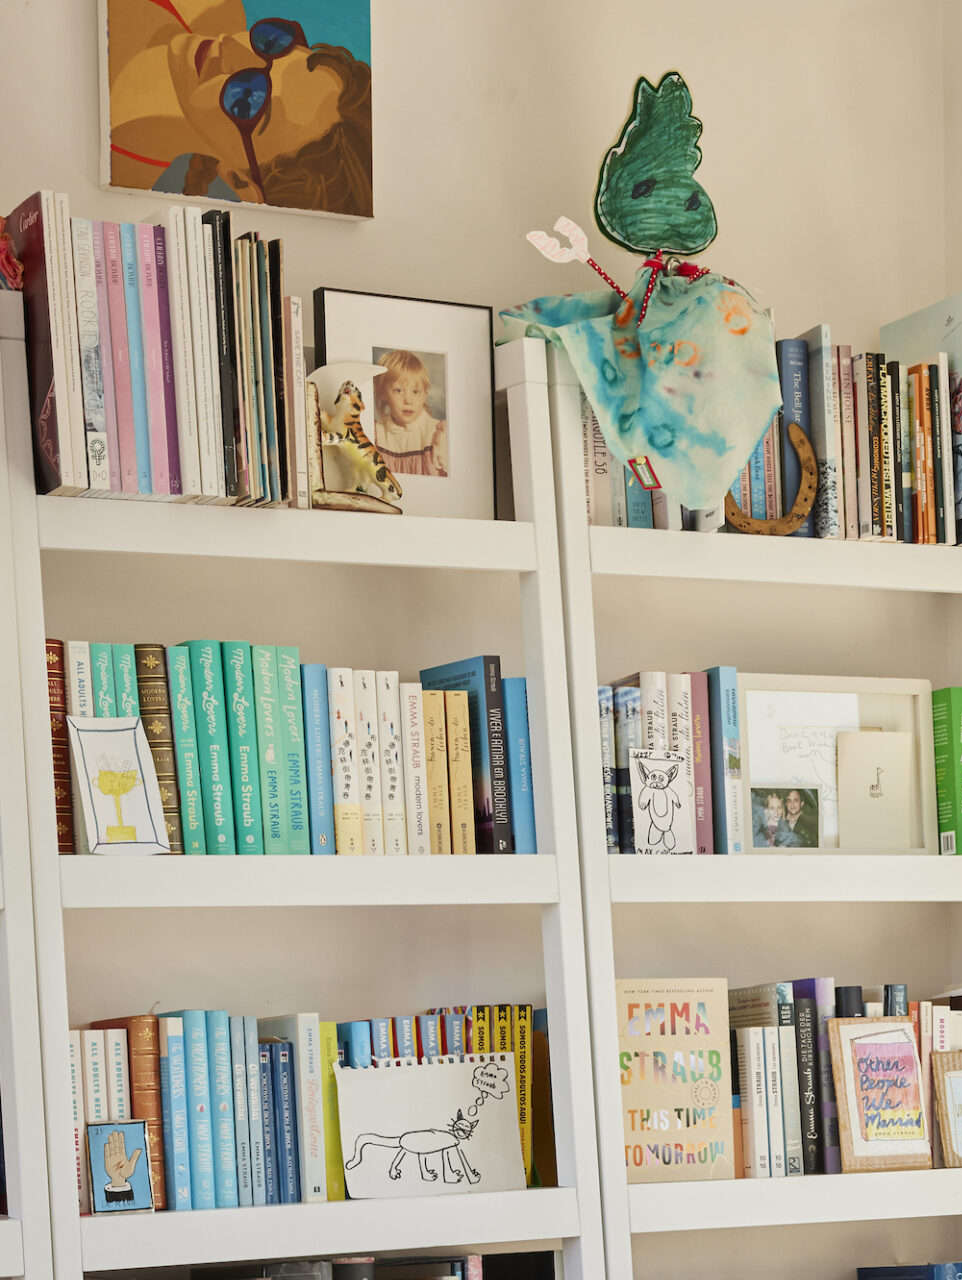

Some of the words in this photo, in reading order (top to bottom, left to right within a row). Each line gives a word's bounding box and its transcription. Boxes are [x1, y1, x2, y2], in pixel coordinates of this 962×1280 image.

[793, 371, 802, 389] The
[843, 370, 851, 390] TIN
[793, 391, 803, 408] Bell
[794, 409, 803, 422] Jar
[844, 392, 852, 424] HOUSE
[884, 487, 893, 526] WINTER
[77, 661, 85, 675] ALL
[97, 652, 109, 691] Modern
[175, 655, 188, 693] Modern
[200, 647, 213, 692] Modern
[231, 649, 245, 693] Modern
[258, 649, 272, 694] Modern
[280, 654, 299, 700] Modern
[79, 679, 87, 708] ADULTS
[99, 691, 114, 717] Love
[312, 689, 321, 725] MODERN
[177, 693, 191, 732] Lovers
[202, 691, 218, 737] Lovers
[233, 693, 249, 738] Lovers
[260, 696, 276, 737] Lovers
[283, 705, 300, 742] Lovers
[408, 695, 417, 727] EMMA
[646, 710, 654, 739] STRAUB
[671, 712, 679, 740] STRAUB
[315, 727, 323, 758] LOVERS
[410, 731, 421, 769] STRAUB
[518, 738, 526, 765] STRAUB
[184, 752, 195, 787] Emma
[209, 745, 220, 781] Emma
[239, 746, 250, 782] Emma
[287, 753, 300, 785] EMMA
[316, 760, 324, 784] EMMA
[267, 770, 279, 798] EMMA
[414, 776, 422, 809] modern
[696, 786, 704, 804] STRAUB
[188, 788, 199, 830] Straub
[213, 784, 224, 826] Straub
[243, 785, 254, 827] Straub
[270, 802, 281, 839] STRAUB
[290, 789, 304, 831] STRAUB
[416, 812, 424, 836] lovers
[403, 1020, 411, 1046] EMMA
[428, 1021, 436, 1047] EMMA
[627, 1002, 710, 1036] EMMA
[379, 1022, 387, 1049] EMMA
[92, 1061, 101, 1093] ADULTS
[115, 1061, 123, 1093] ADULTS
[172, 1055, 185, 1098] VACATIONERS
[192, 1043, 207, 1096] VACATIONERS
[215, 1043, 229, 1095] VACATIONERS
[619, 1050, 722, 1085] STRAUB
[857, 1052, 905, 1073] Other
[519, 1074, 527, 1106] ADULTOS
[802, 1068, 815, 1105] Straub
[860, 1074, 911, 1096] People
[117, 1097, 125, 1119] HERE
[862, 1092, 902, 1111] We
[173, 1110, 184, 1127] EMMA
[196, 1119, 208, 1141] EMMA
[220, 1118, 230, 1140] EMMA
[627, 1109, 670, 1131] THIS
[674, 1107, 717, 1129] TIME
[806, 1108, 818, 1139] Emma
[864, 1112, 922, 1129] Married
[174, 1128, 186, 1154] STRAUB
[220, 1143, 233, 1171] STRAUB
[625, 1141, 725, 1167] TOMORROW
[197, 1144, 210, 1172] STRAUB
